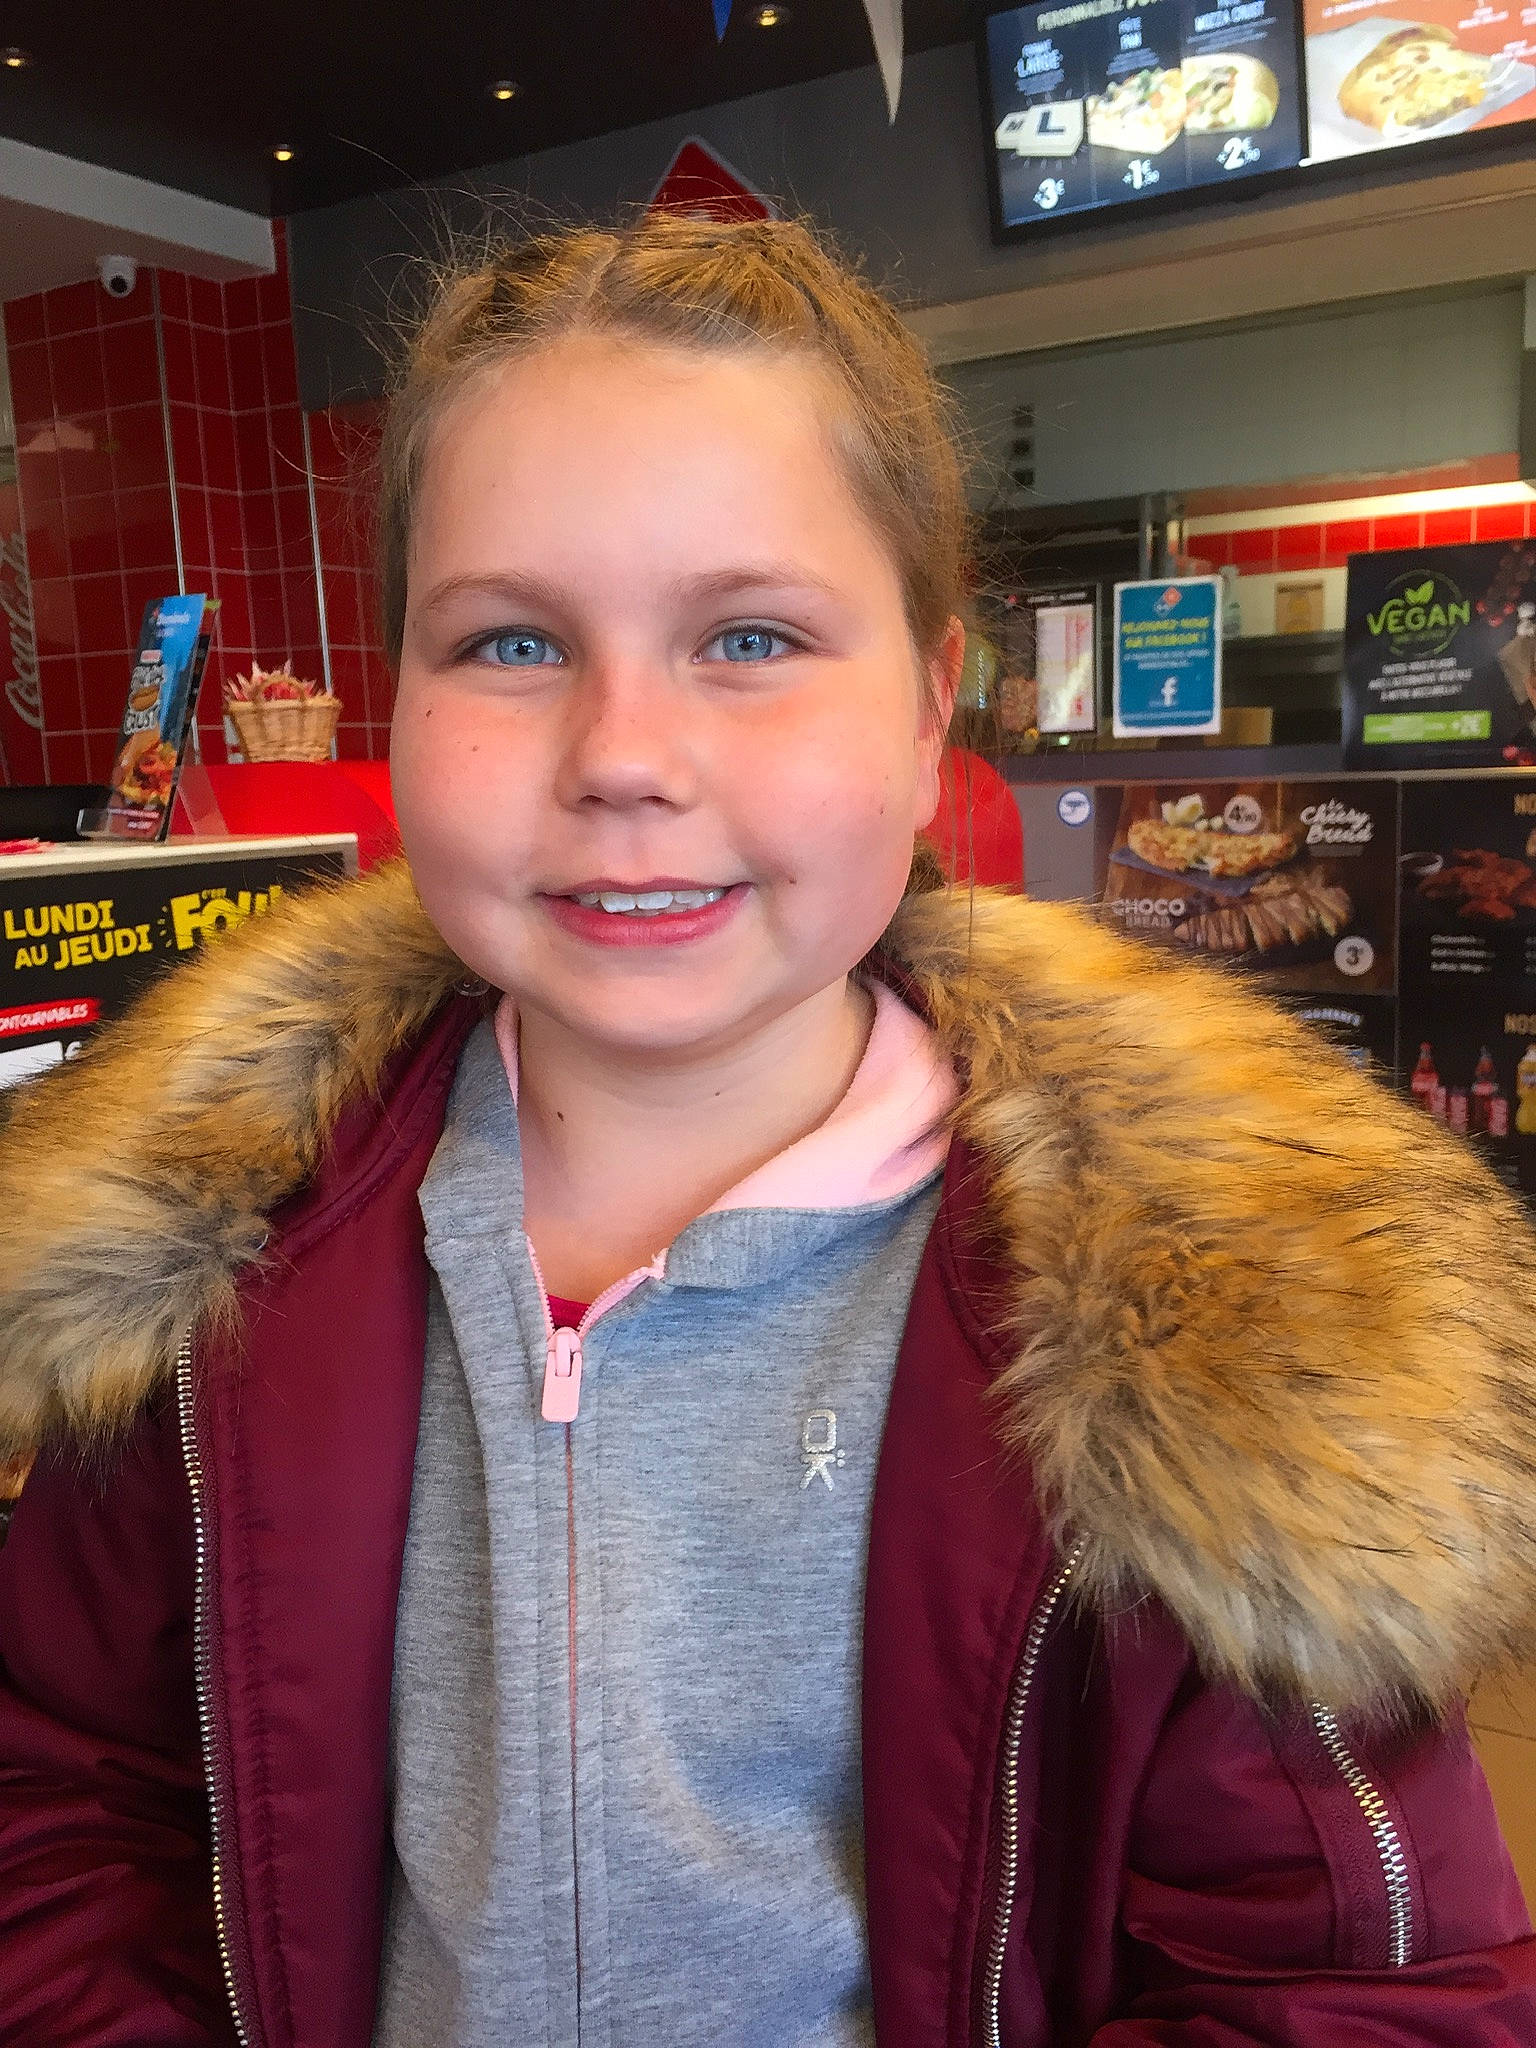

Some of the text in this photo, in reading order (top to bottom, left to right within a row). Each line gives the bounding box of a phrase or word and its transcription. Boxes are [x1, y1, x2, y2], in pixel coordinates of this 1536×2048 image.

[1038, 111, 1064, 133] L
[1367, 599, 1471, 636] VEGAN
[4, 900, 115, 940] LUNDI
[1110, 897, 1186, 916] CHOCO
[14, 924, 153, 971] AU JEUDI
